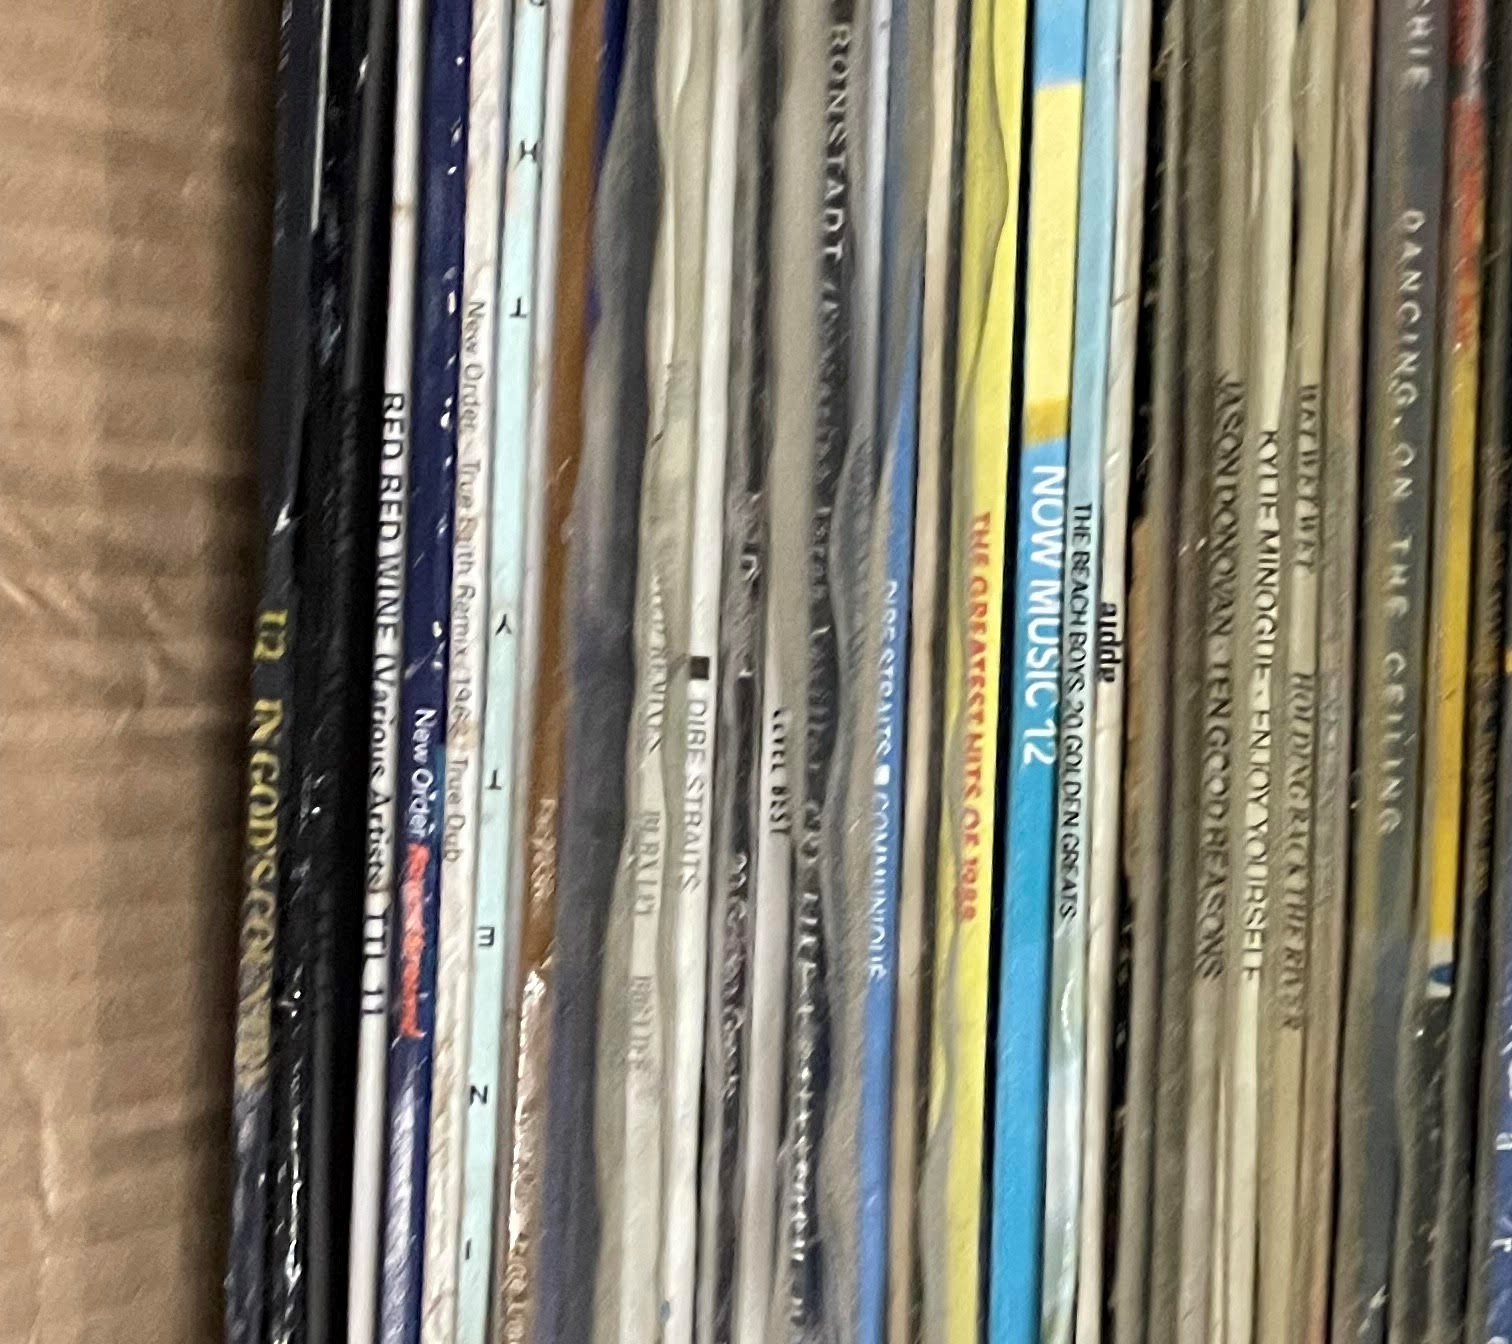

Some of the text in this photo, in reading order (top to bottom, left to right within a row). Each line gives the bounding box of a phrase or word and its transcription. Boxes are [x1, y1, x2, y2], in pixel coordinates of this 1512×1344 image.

[464, 300, 488, 358] New
[1388, 209, 1425, 411] DANCING
[381, 391, 406, 460] RED
[461, 362, 485, 432] Order
[378, 473, 403, 542] RED
[458, 457, 481, 514] True
[1386, 444, 1417, 502] ON
[968, 512, 993, 566] THE
[1070, 503, 1093, 544] THE
[373, 553, 400, 641] WINE
[1068, 548, 1091, 625] BEACH
[1383, 534, 1413, 618] THE
[252, 608, 288, 662] U2
[452, 583, 476, 659] Remix
[964, 575, 990, 725] GREATEST
[1023, 464, 1068, 767] NOW MUSIC 12
[874, 647, 895, 758] STRAITS
[1194, 370, 1246, 983] JASON DONOVAN TEN GOOD REASONS
[1239, 429, 1281, 984] KYLIE MINOGUE ENJOY YOURSELF
[249, 698, 284, 741] IN
[368, 654, 396, 777] (Various
[412, 708, 437, 763] New
[1062, 698, 1084, 730] 20
[1376, 651, 1407, 836] CEILING
[446, 757, 468, 808] True
[679, 698, 708, 894] DIRE STRAITS
[961, 733, 984, 802] HITS
[1060, 733, 1083, 827] GOLDEN
[244, 754, 282, 879] GOD'S
[408, 768, 435, 838] Order
[443, 812, 466, 864] Dub
[769, 783, 791, 837] BEST
[960, 807, 980, 849] OF
[366, 788, 391, 896] Artists)
[1059, 833, 1080, 922] GREATS
